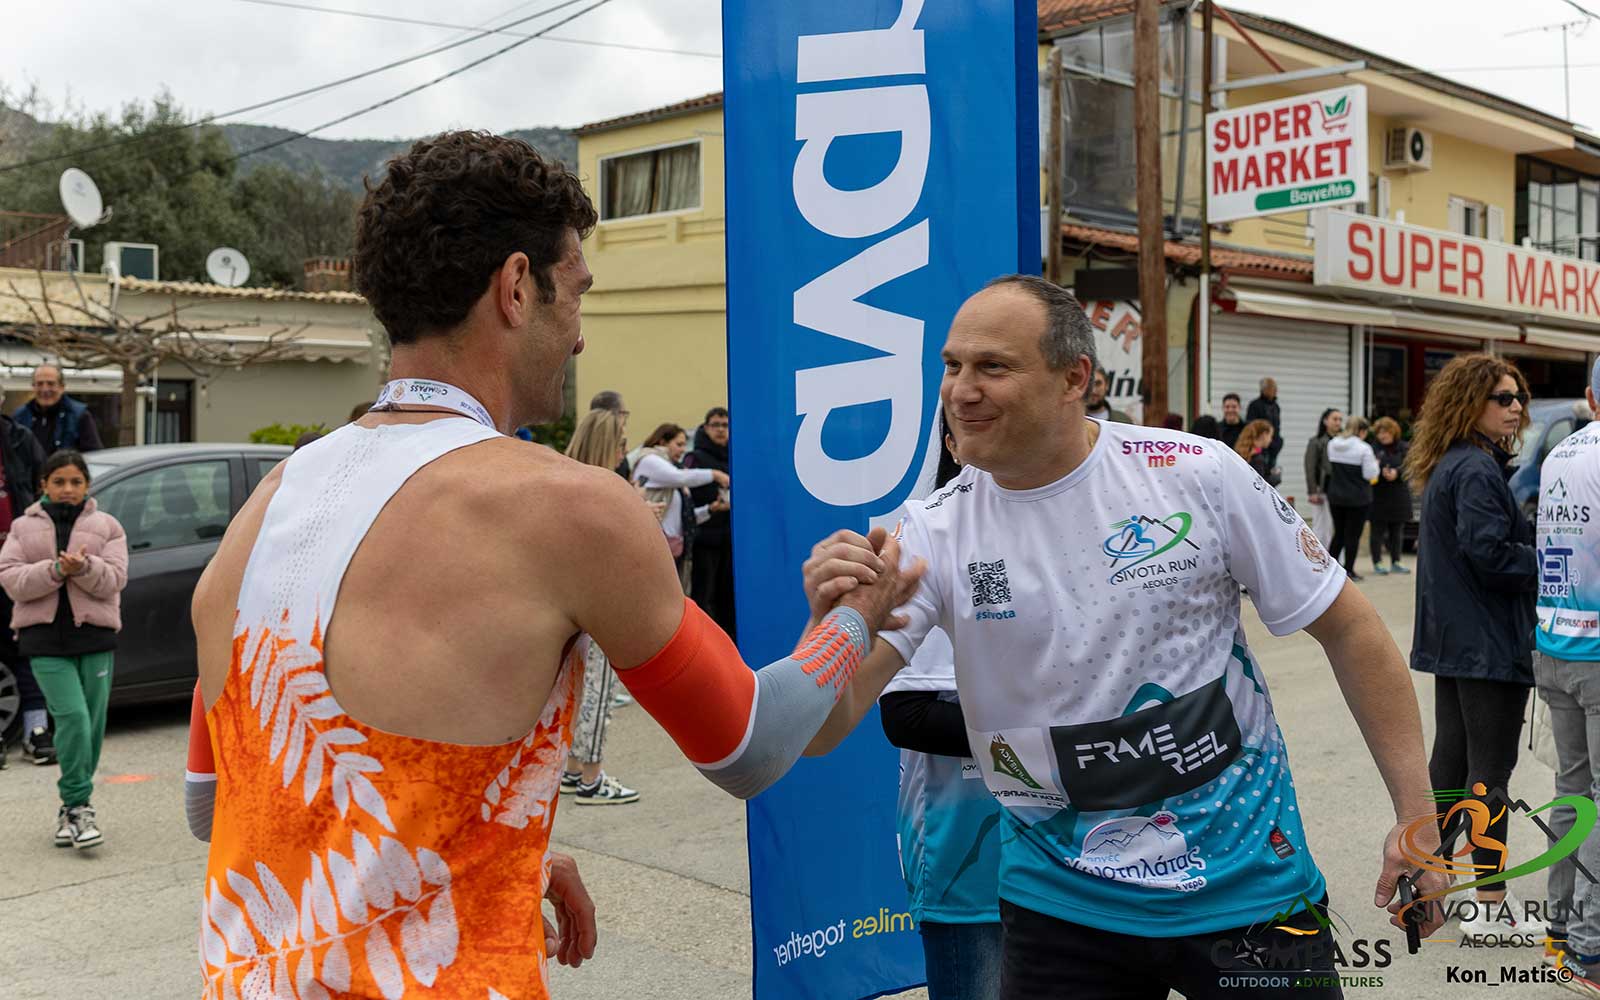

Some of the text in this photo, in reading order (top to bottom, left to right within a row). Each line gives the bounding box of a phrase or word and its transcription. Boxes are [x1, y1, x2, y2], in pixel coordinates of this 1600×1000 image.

[1213, 103, 1312, 153] SUPER
[1213, 139, 1352, 196] MARKET
[1347, 222, 1600, 316] SUPER MARK
[1148, 455, 1176, 467] me
[1116, 558, 1198, 583] SIVOTA RUN
[1142, 576, 1178, 590] AEOLOS
[976, 609, 1016, 621] #sivota
[1074, 723, 1229, 775] FRAME REEL
